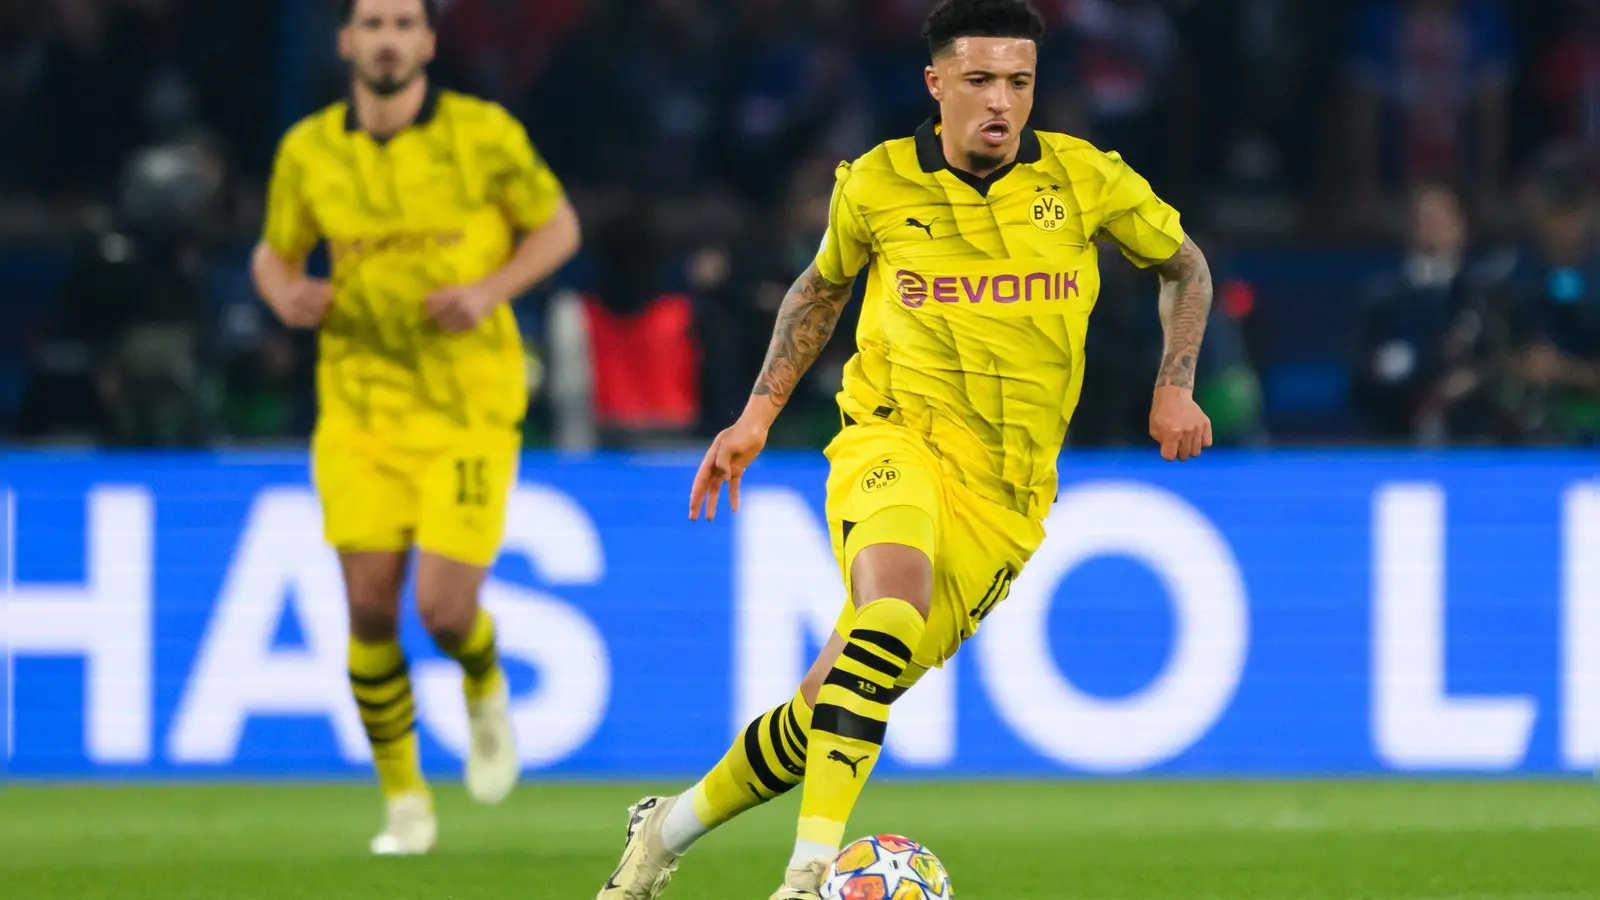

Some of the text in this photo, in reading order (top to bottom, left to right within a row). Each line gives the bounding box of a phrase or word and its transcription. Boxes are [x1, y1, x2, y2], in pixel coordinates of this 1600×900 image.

[1034, 197, 1065, 221] BVB
[1043, 219, 1056, 229] 09
[933, 270, 1079, 304] EVONIK
[455, 458, 489, 508] 15
[866, 468, 897, 489] BVB
[0, 482, 609, 768] HAS
[732, 481, 1250, 772] NO
[857, 680, 877, 694] 19
